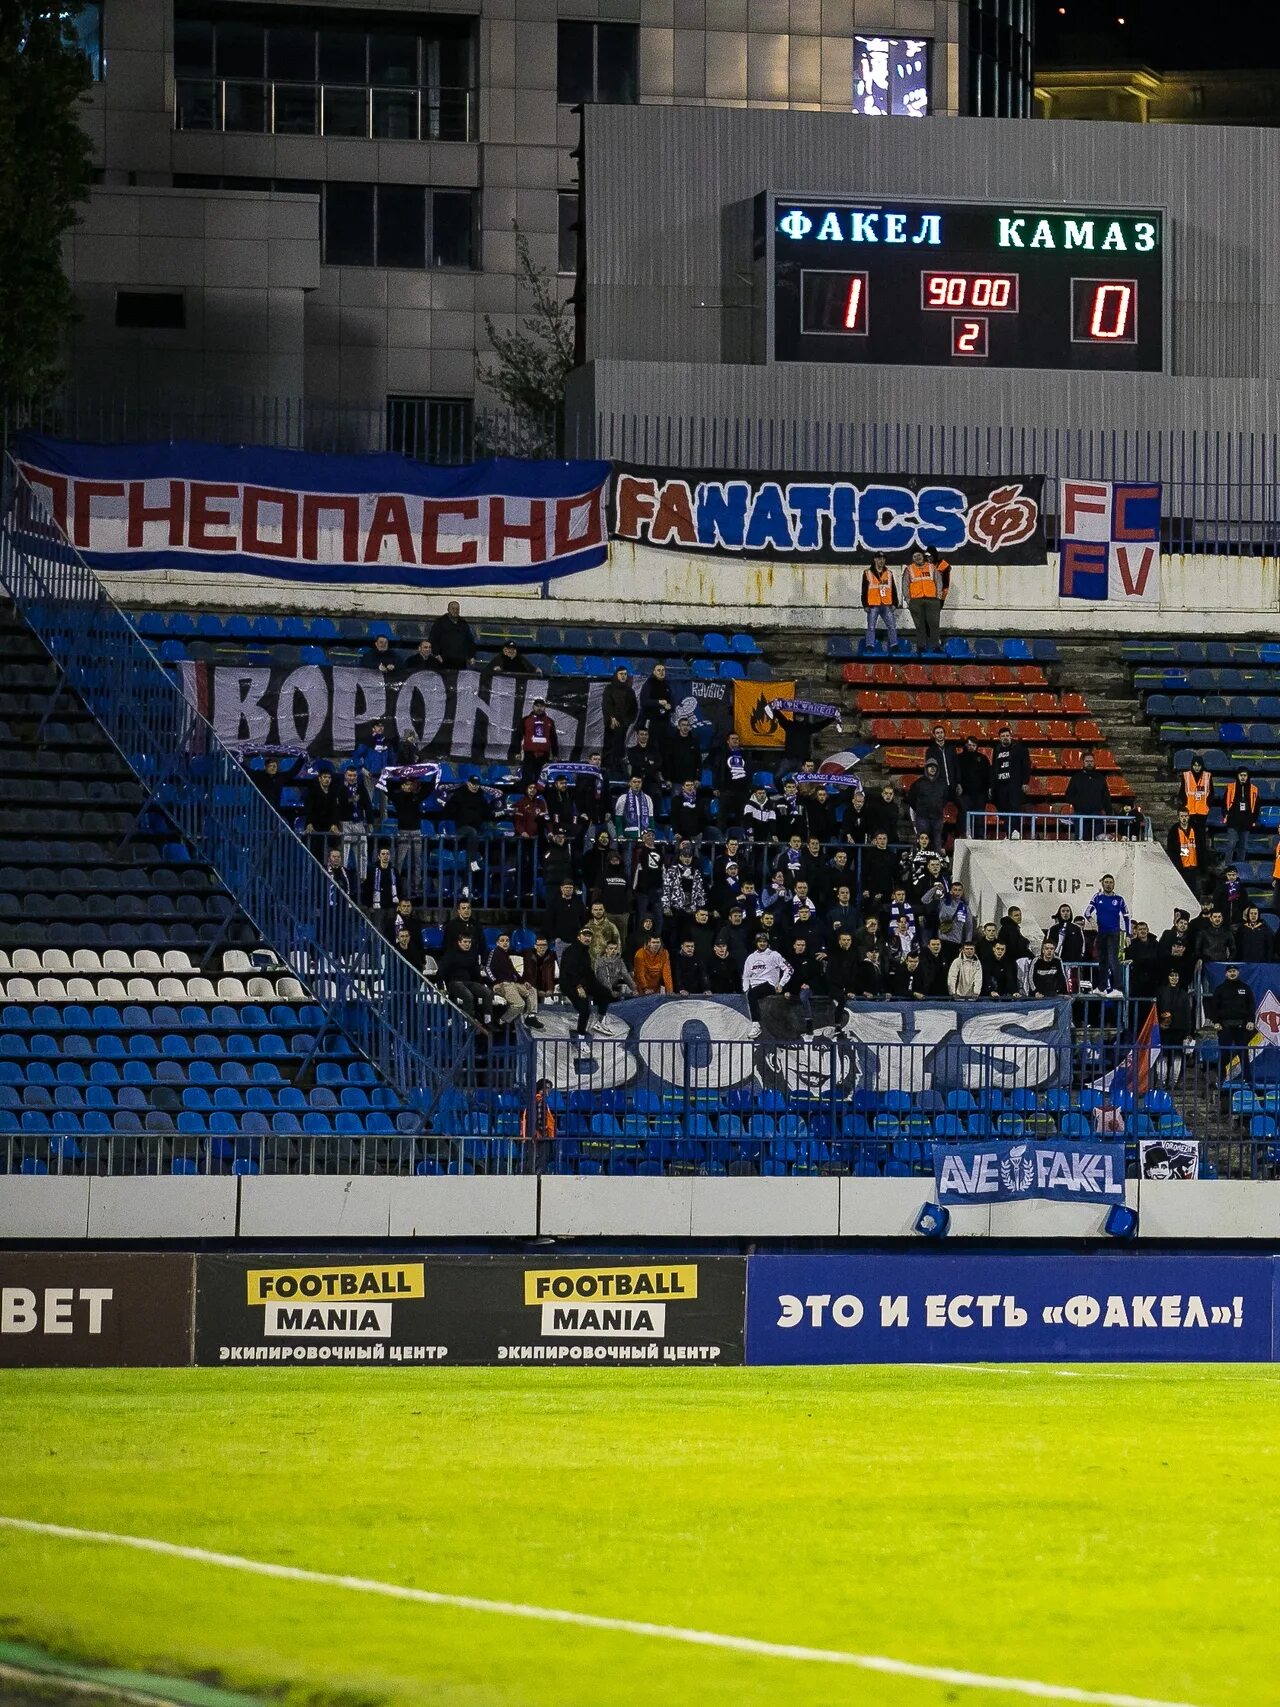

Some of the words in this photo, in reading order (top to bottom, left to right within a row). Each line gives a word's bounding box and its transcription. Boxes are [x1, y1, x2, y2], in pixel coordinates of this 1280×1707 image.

[780, 210, 942, 245] ФАКЕЛ
[998, 218, 1156, 251] КАМАЗ
[845, 279, 861, 329] 1
[1090, 285, 1131, 338] 0
[958, 323, 980, 351] 2
[616, 472, 968, 553] FANATICS
[939, 1153, 999, 1194] AVE
[1035, 1150, 1122, 1194] FAKEL
[259, 1271, 412, 1299] FOOTBALL
[536, 1272, 685, 1299] FOOTBALL
[1, 1287, 114, 1334] BET
[276, 1308, 381, 1331] MANIA
[553, 1308, 654, 1331] MANIA
[776, 1295, 865, 1328] ЭТО
[880, 1295, 910, 1328] И
[925, 1295, 1029, 1328] ЕСТЬ
[219, 1343, 385, 1360] ЭКИПИРОВОЧНЫЙ
[389, 1346, 448, 1361] ЦЕНТР
[497, 1343, 657, 1360] ЭКИПИРОВОЧНЫЙ
[663, 1346, 721, 1361] ЦЕНТР
